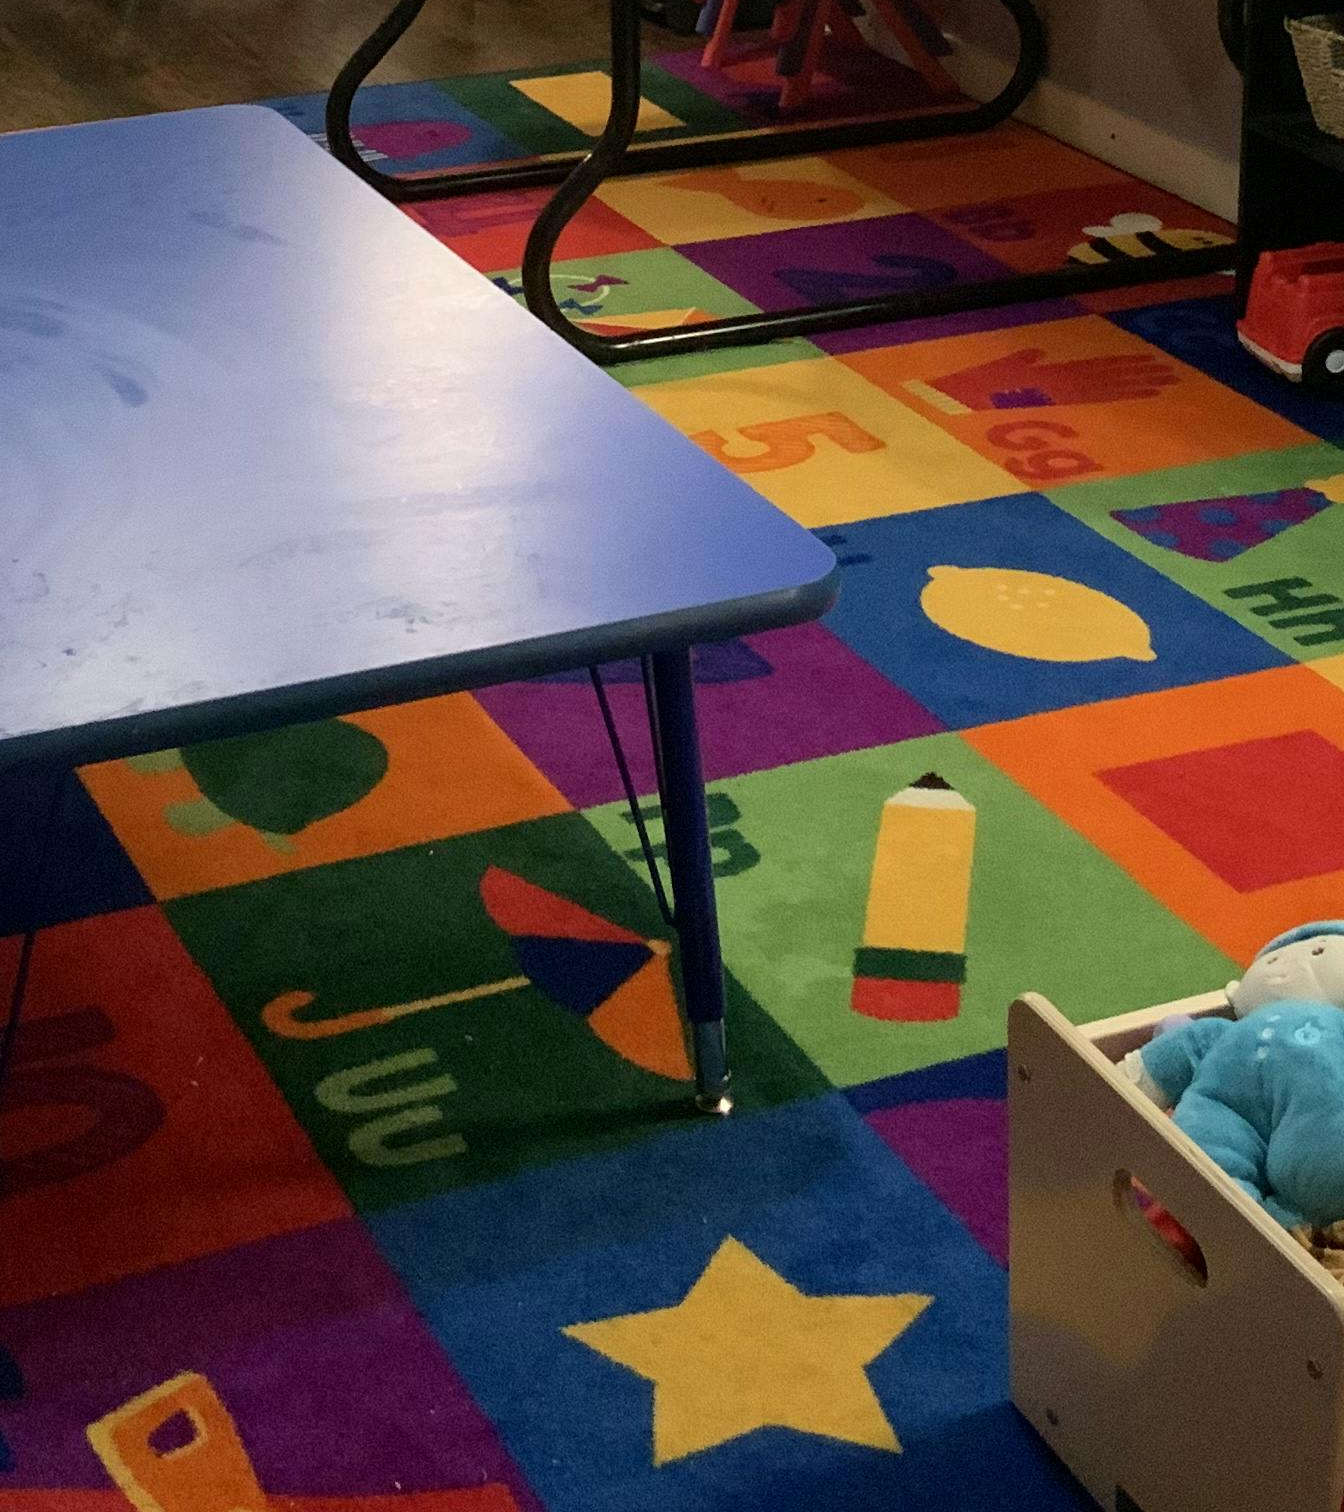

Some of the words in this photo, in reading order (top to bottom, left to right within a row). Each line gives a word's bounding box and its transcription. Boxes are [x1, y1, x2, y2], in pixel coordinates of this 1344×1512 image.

[693, 412, 887, 474] 5
[985, 419, 1102, 480] Gg
[313, 1047, 468, 1168] Uu
